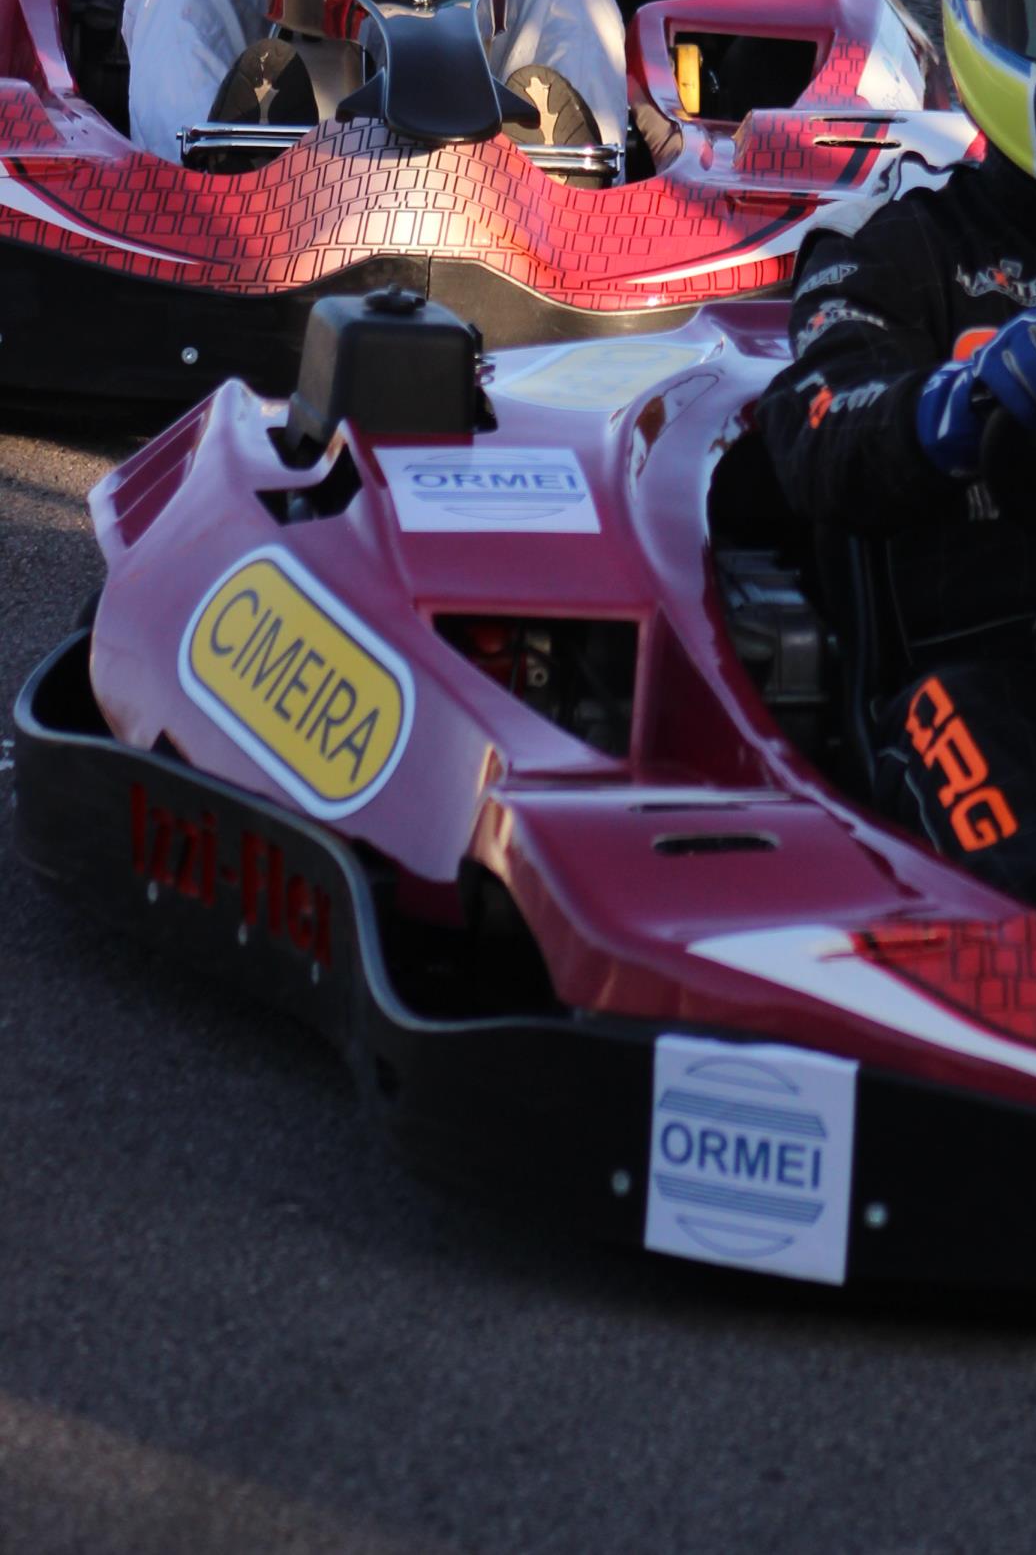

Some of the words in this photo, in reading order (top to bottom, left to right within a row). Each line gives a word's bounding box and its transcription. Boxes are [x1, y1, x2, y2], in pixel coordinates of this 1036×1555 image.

[412, 471, 578, 492] ORMEI
[209, 588, 380, 785] CIMEIRA
[905, 675, 1020, 853] CRG
[660, 1121, 822, 1191] ORMEI
